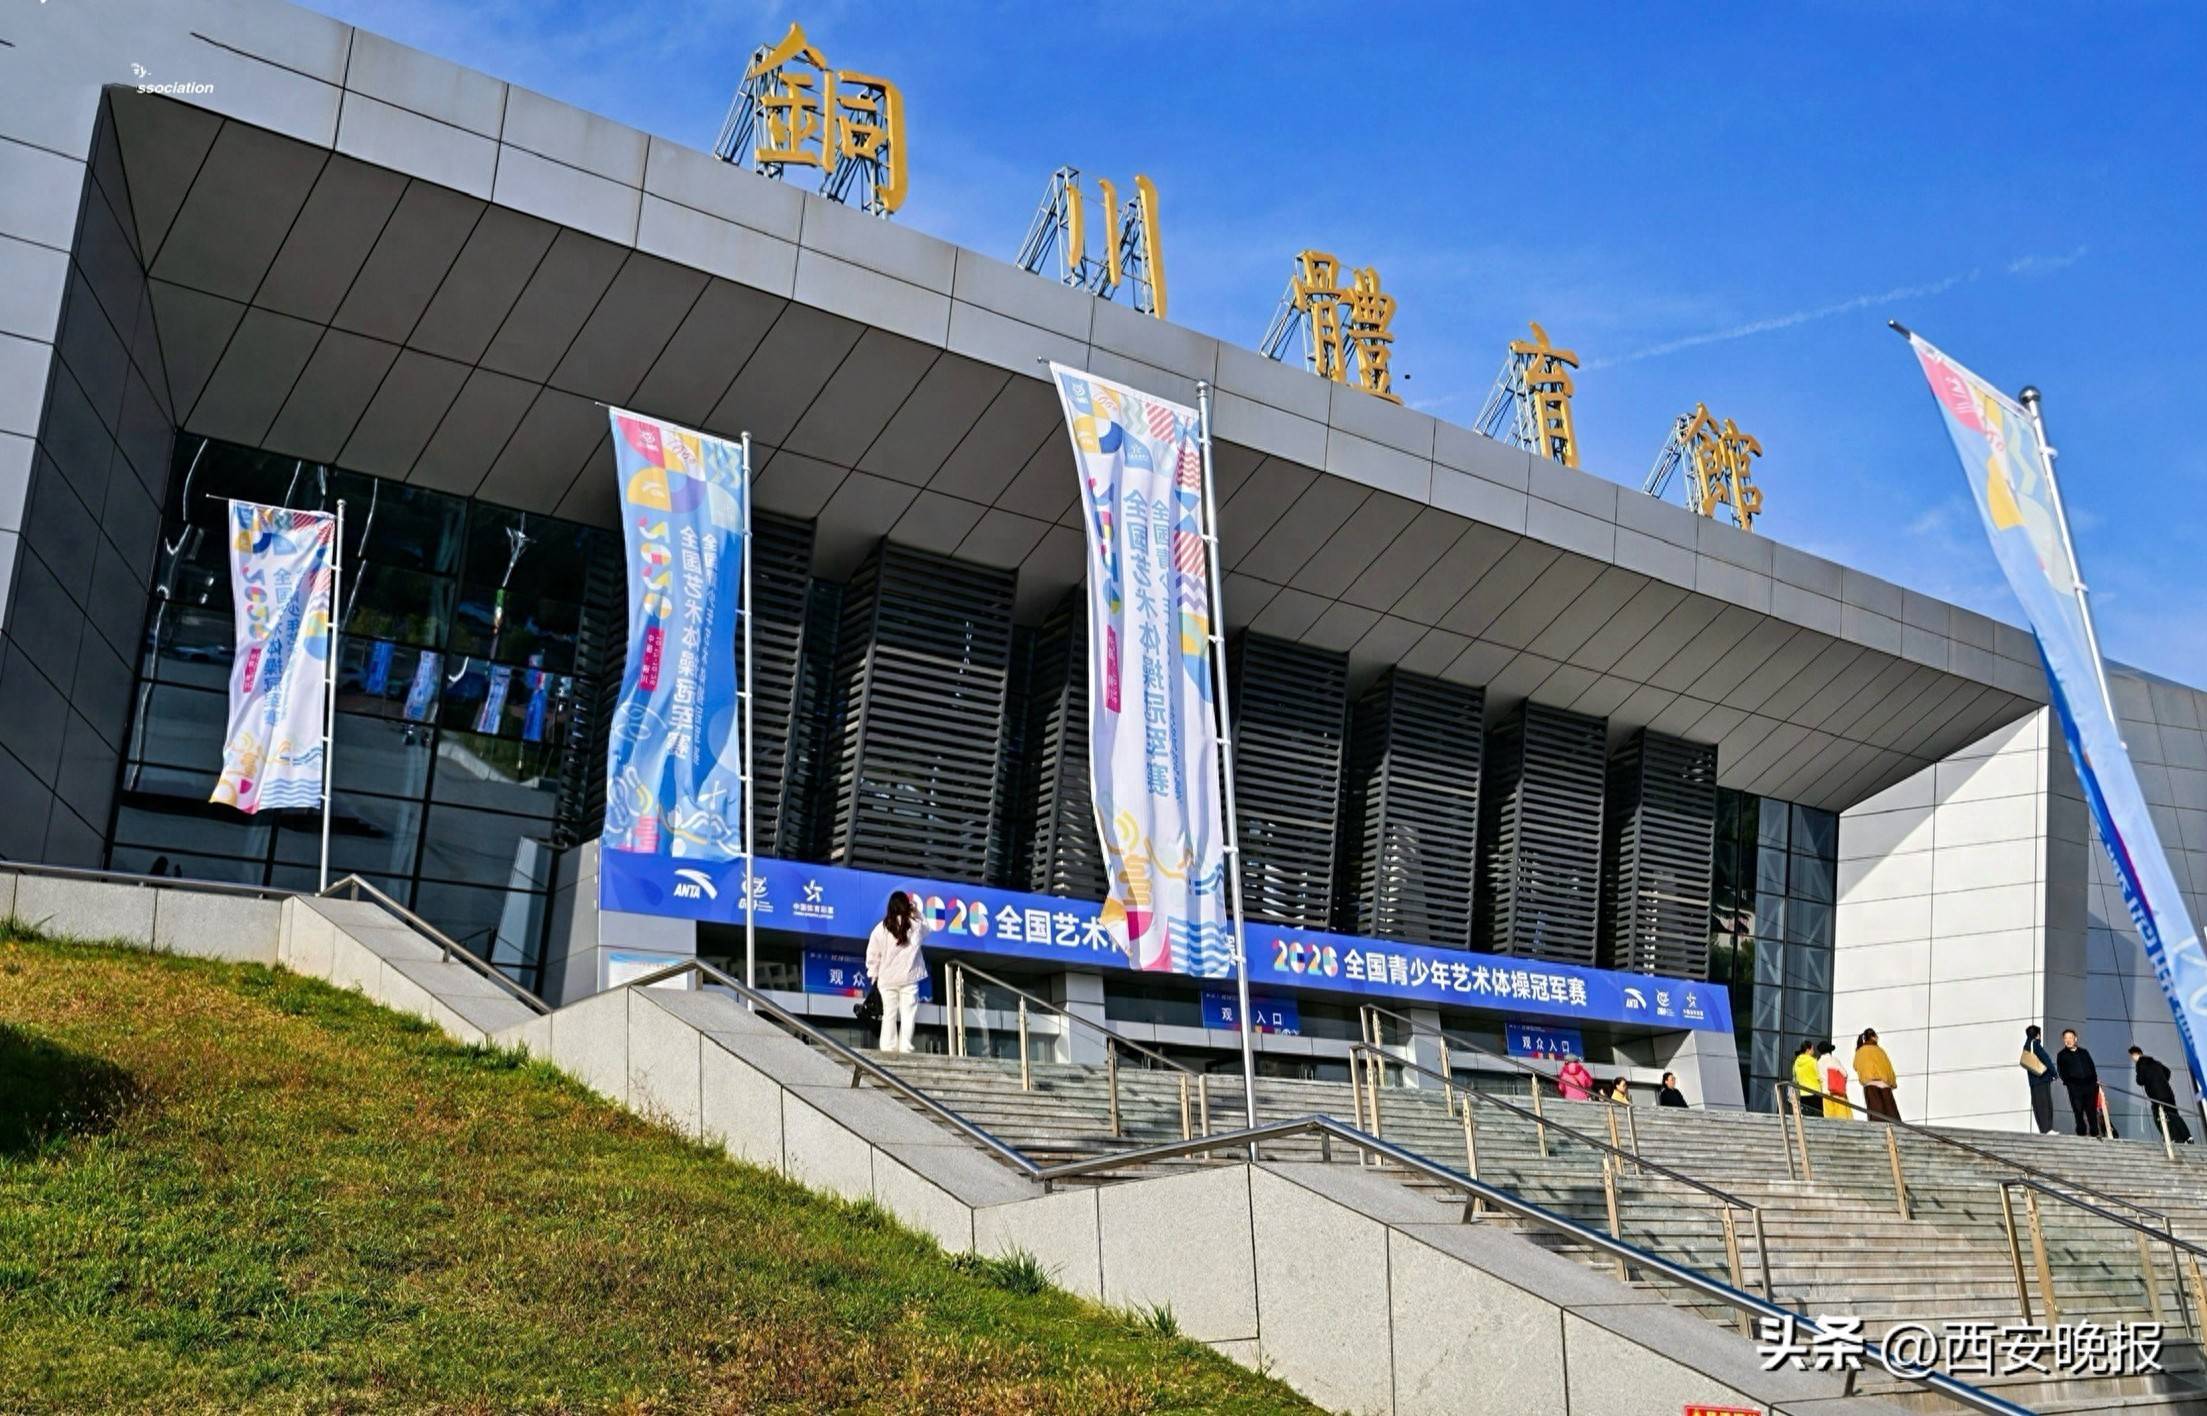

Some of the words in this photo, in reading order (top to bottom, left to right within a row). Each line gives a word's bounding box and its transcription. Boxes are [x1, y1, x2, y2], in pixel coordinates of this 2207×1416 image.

[673, 883, 700, 899] ANTA
[1271, 938, 1338, 978] 2026
[1343, 948, 1587, 1007] 全国青少年艺术体操冠军赛
[1521, 1035, 1570, 1053] 观众入口
